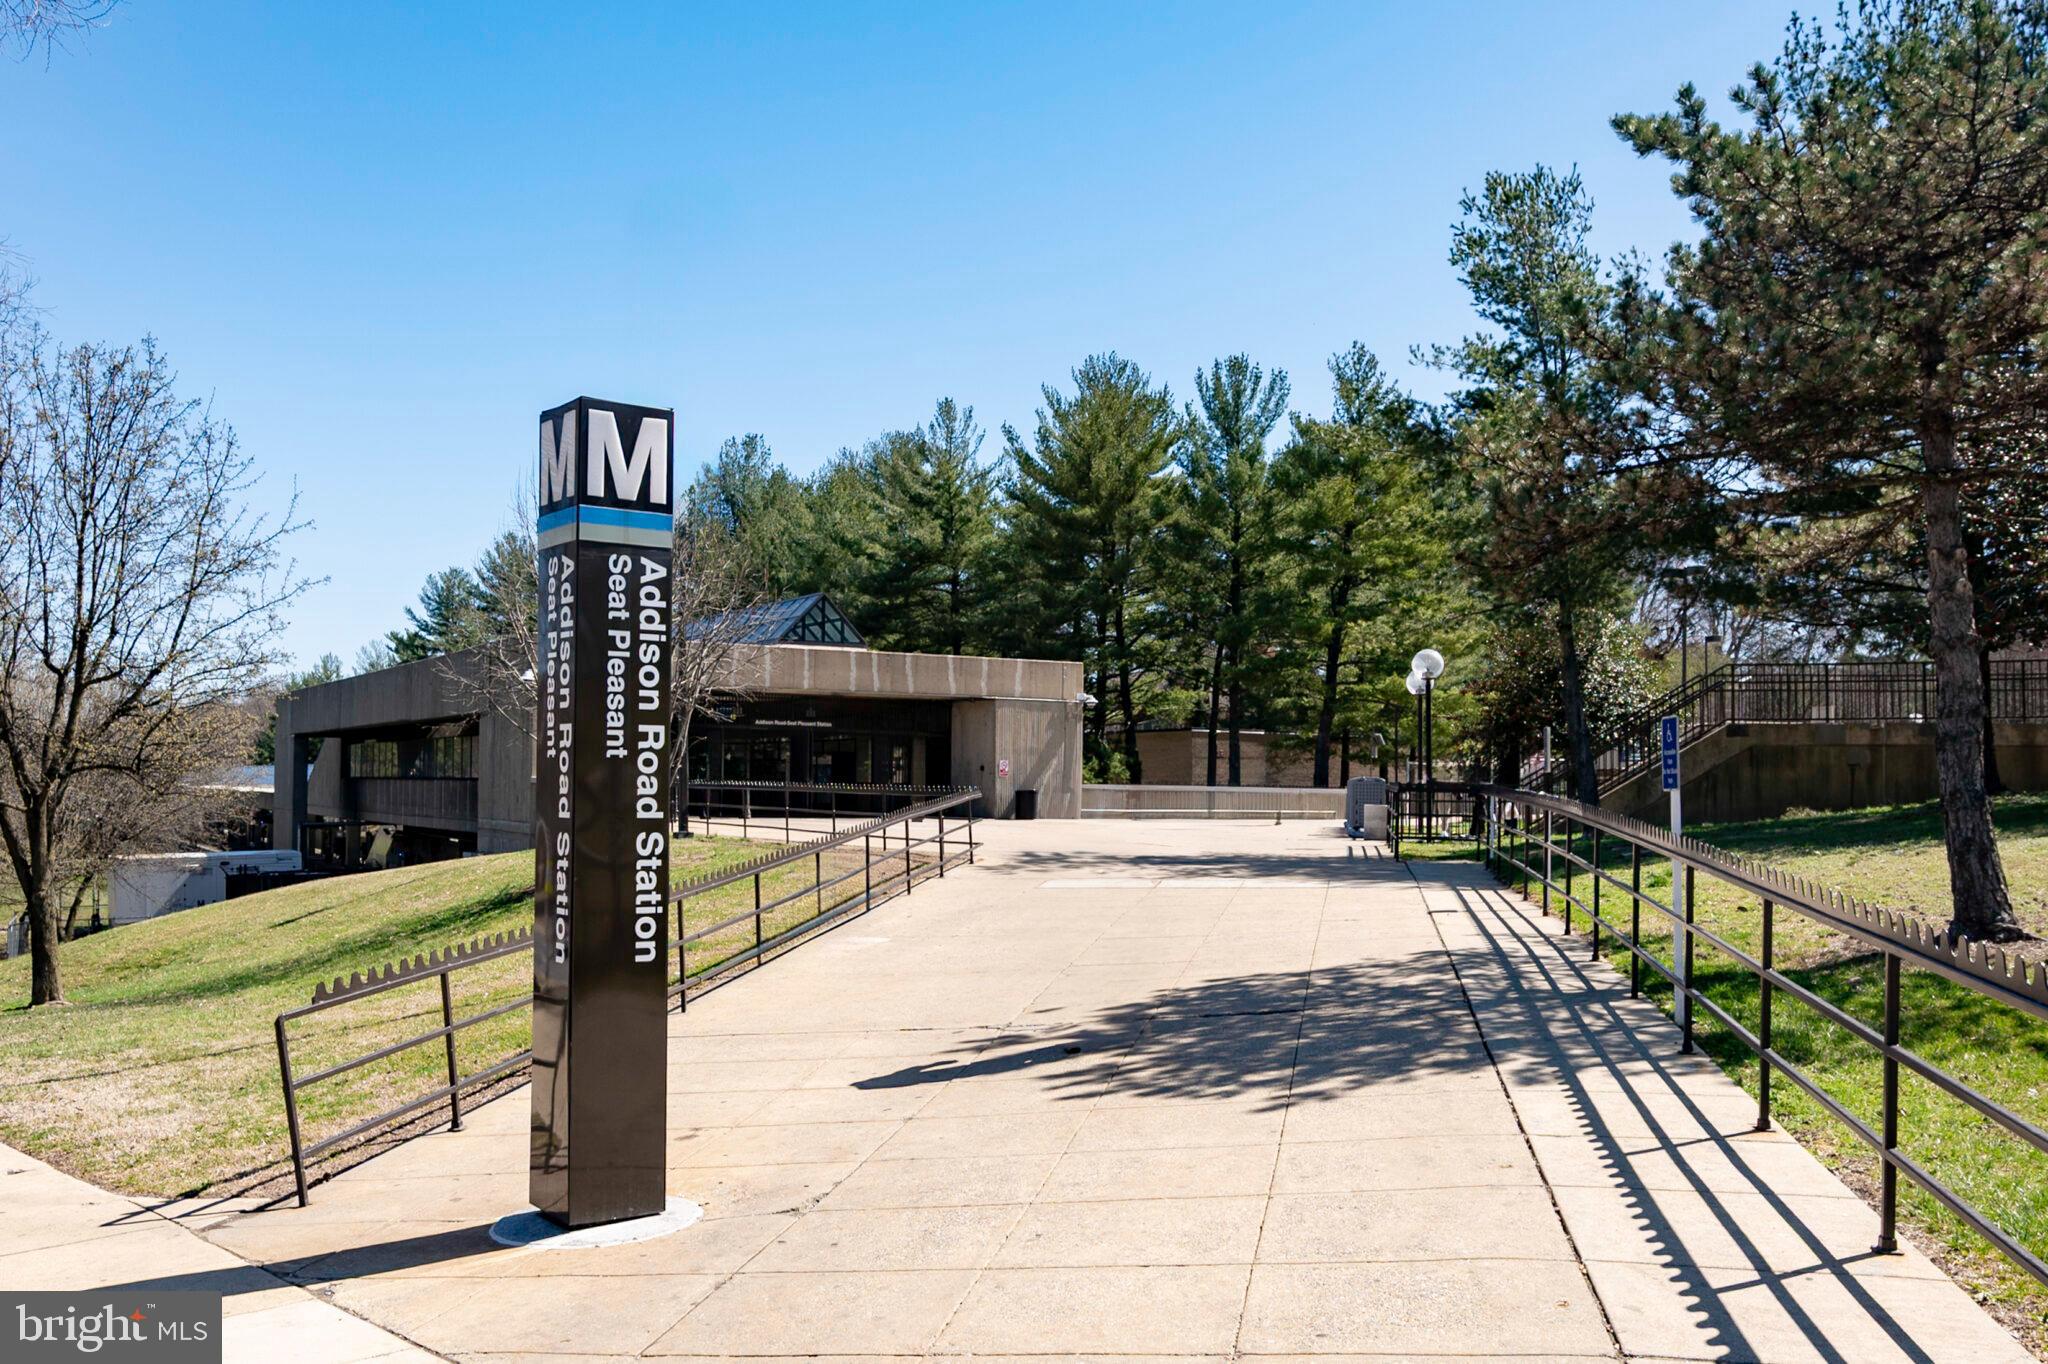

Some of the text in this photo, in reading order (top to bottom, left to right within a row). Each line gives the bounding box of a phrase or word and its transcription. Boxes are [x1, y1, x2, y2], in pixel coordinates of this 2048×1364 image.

[540, 409, 576, 506] M
[587, 408, 667, 504] M
[546, 556, 558, 758] Seat Pleasant
[606, 553, 632, 758] Seat Pleasant
[555, 555, 574, 964] Addison Road Station
[634, 556, 667, 963] Addison Road Station
